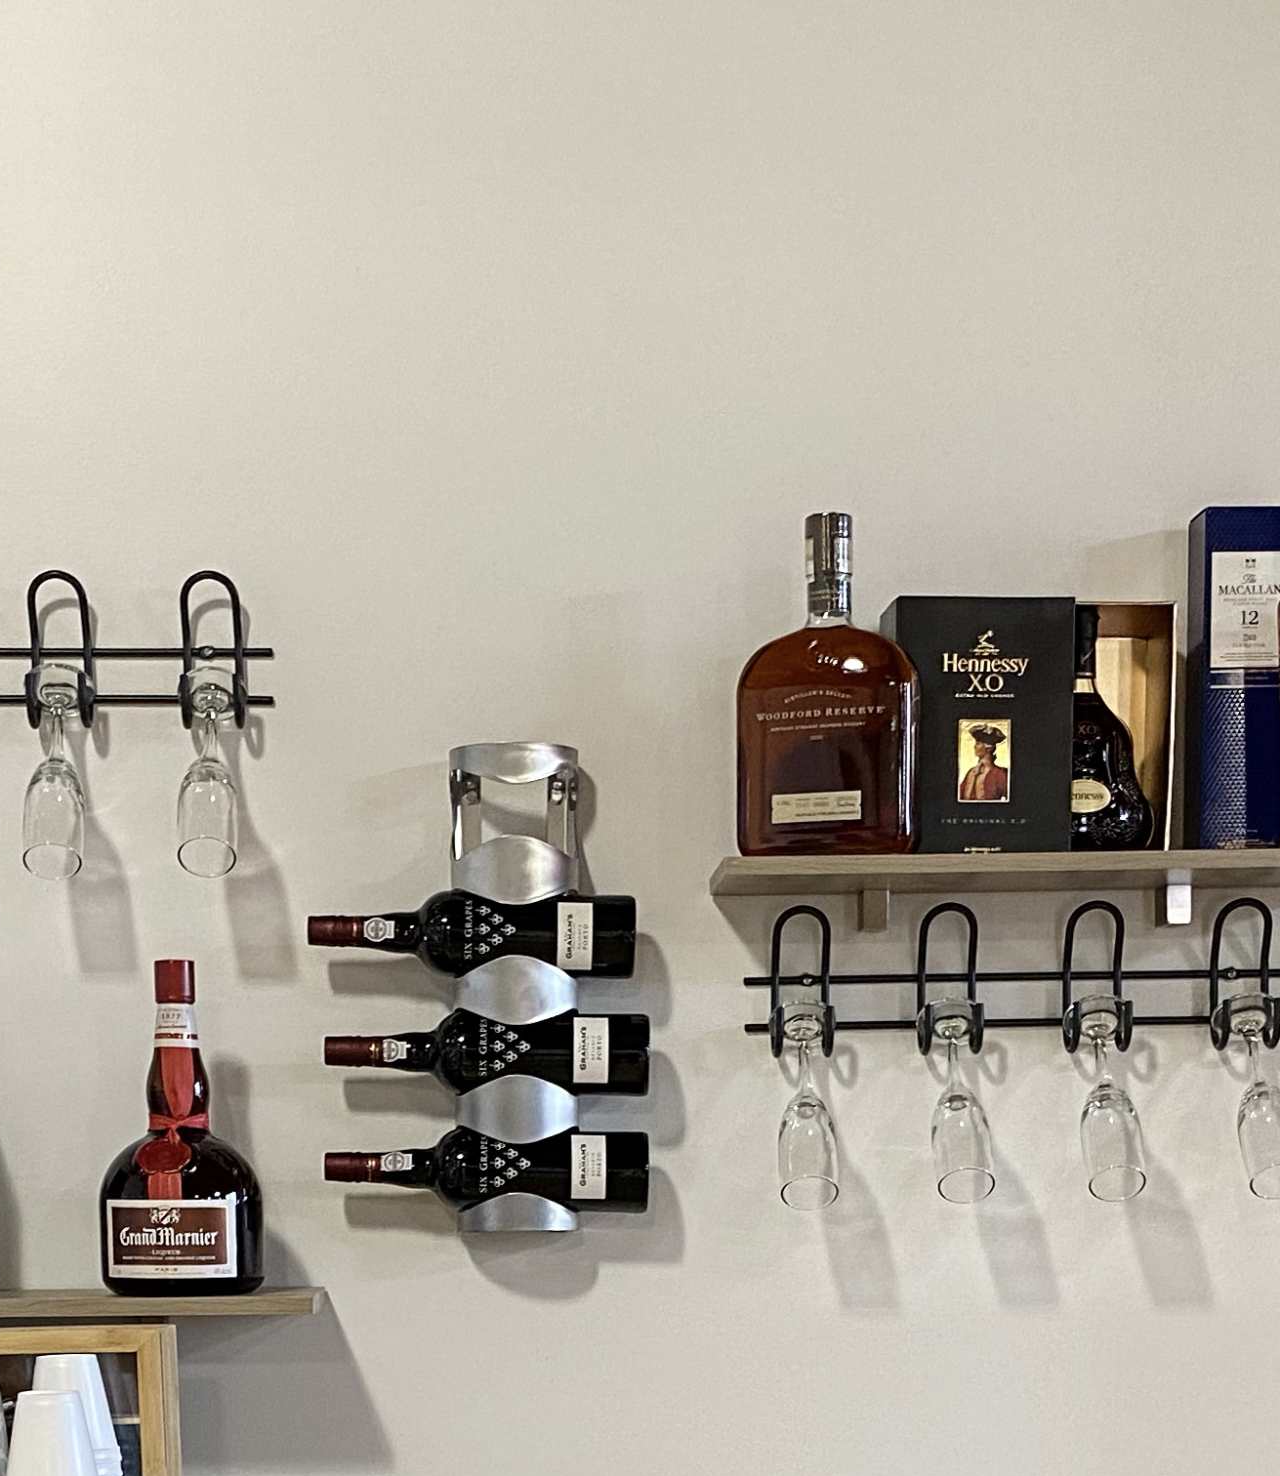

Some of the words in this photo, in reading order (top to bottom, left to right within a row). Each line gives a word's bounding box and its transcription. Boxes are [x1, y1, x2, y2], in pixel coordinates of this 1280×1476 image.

[1241, 610, 1259, 625] 12
[942, 652, 1030, 677] Hennessy
[755, 709, 821, 721] WOODFORD
[825, 705, 886, 717] RESERVE
[463, 899, 473, 938] GRAPES
[565, 913, 573, 959] GRAHAM'S
[463, 942, 473, 960] SIX
[579, 1026, 587, 1071] GRAHAM'S
[478, 1059, 488, 1077] SIX
[578, 1143, 587, 1187] GRAHAM'S
[479, 1176, 488, 1194] SIX
[120, 1226, 157, 1246] Grand
[157, 1226, 218, 1246] Marnier
